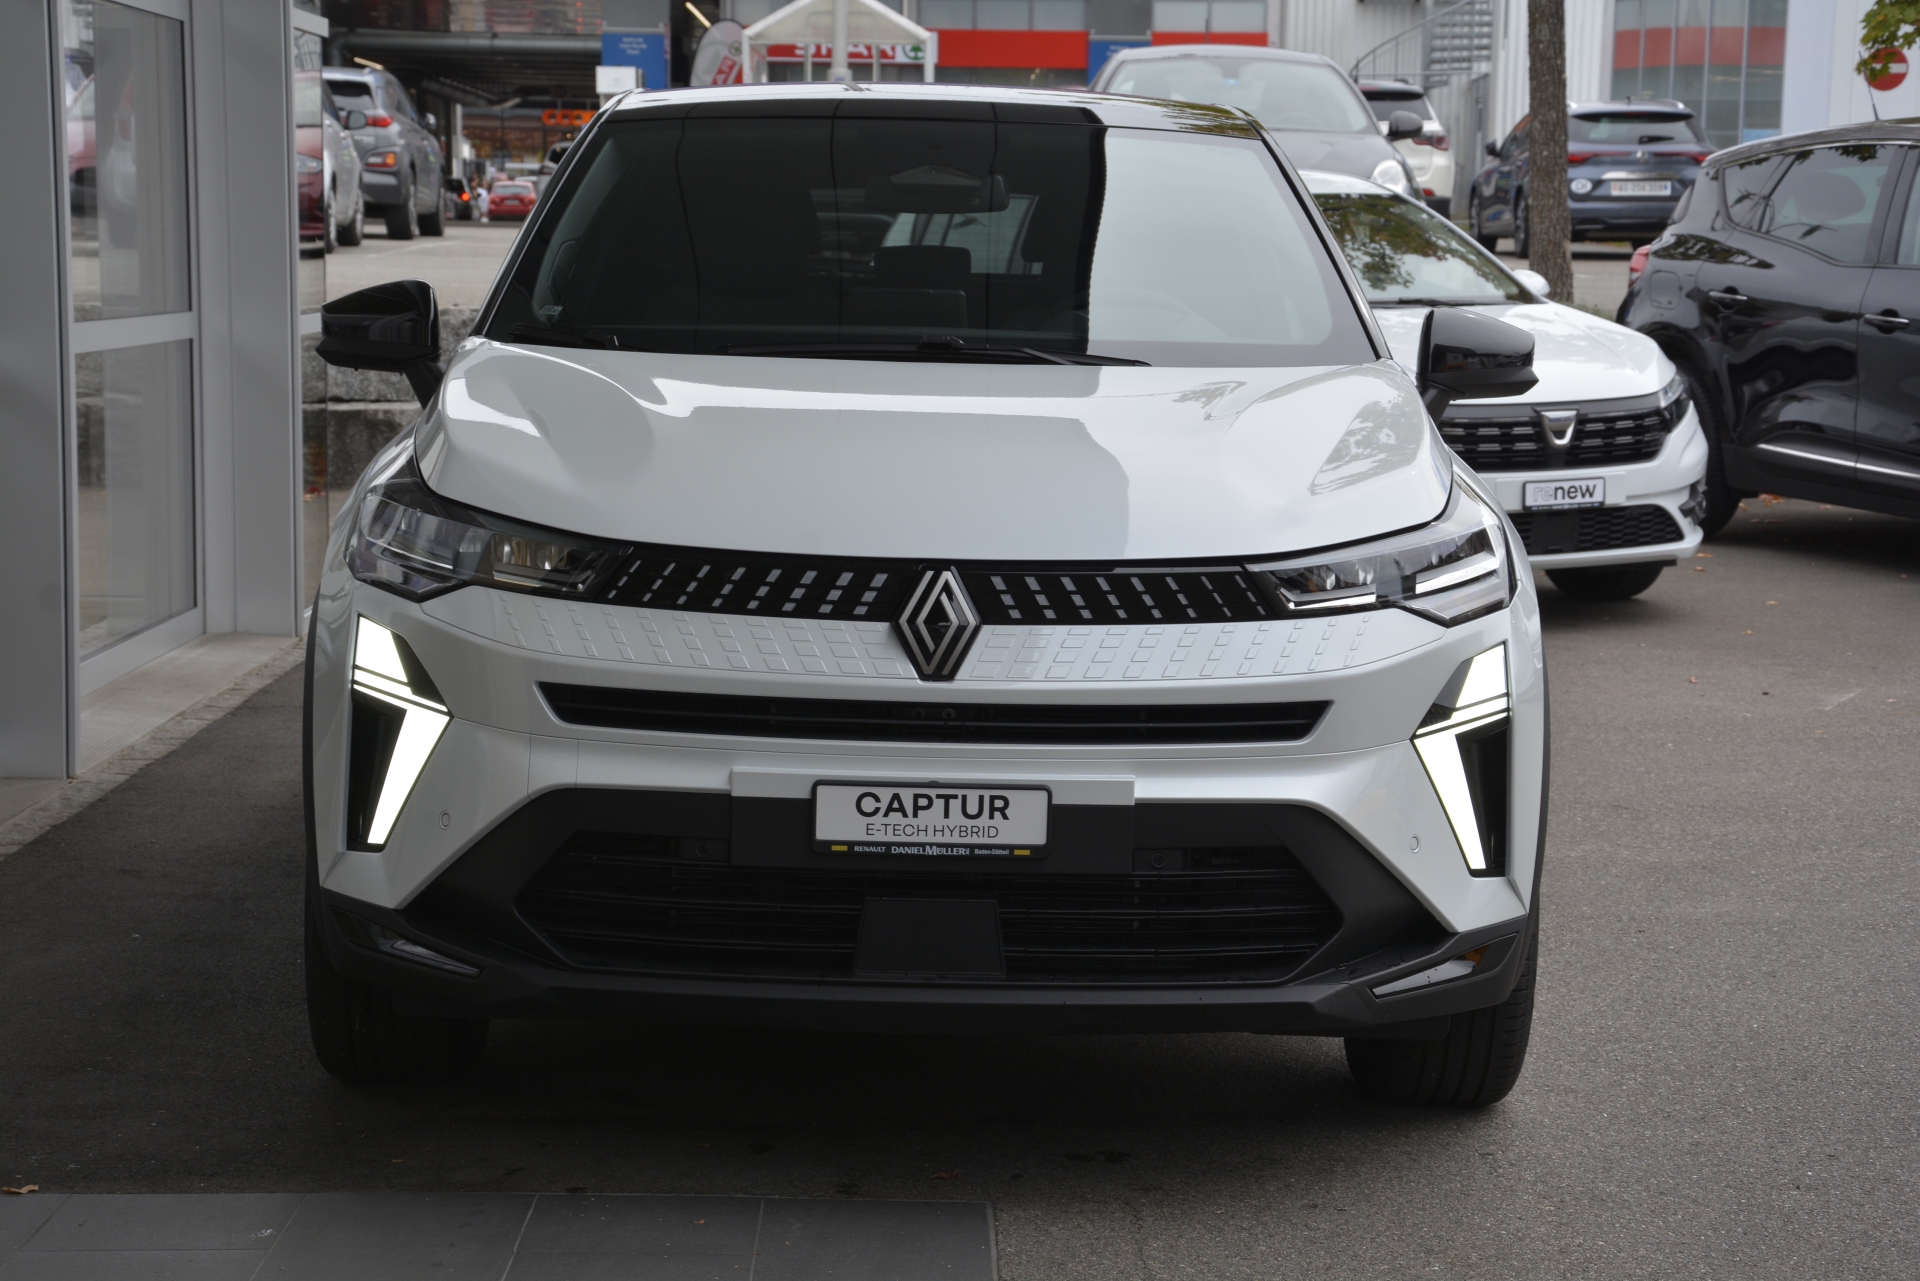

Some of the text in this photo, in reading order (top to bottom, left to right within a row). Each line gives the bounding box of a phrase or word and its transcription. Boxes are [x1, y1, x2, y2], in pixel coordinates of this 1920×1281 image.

[1533, 484, 1597, 503] renew
[855, 791, 1010, 820] CAPTUR
[865, 822, 999, 839] E-TECH HYBRID
[854, 845, 886, 853] RENAULT
